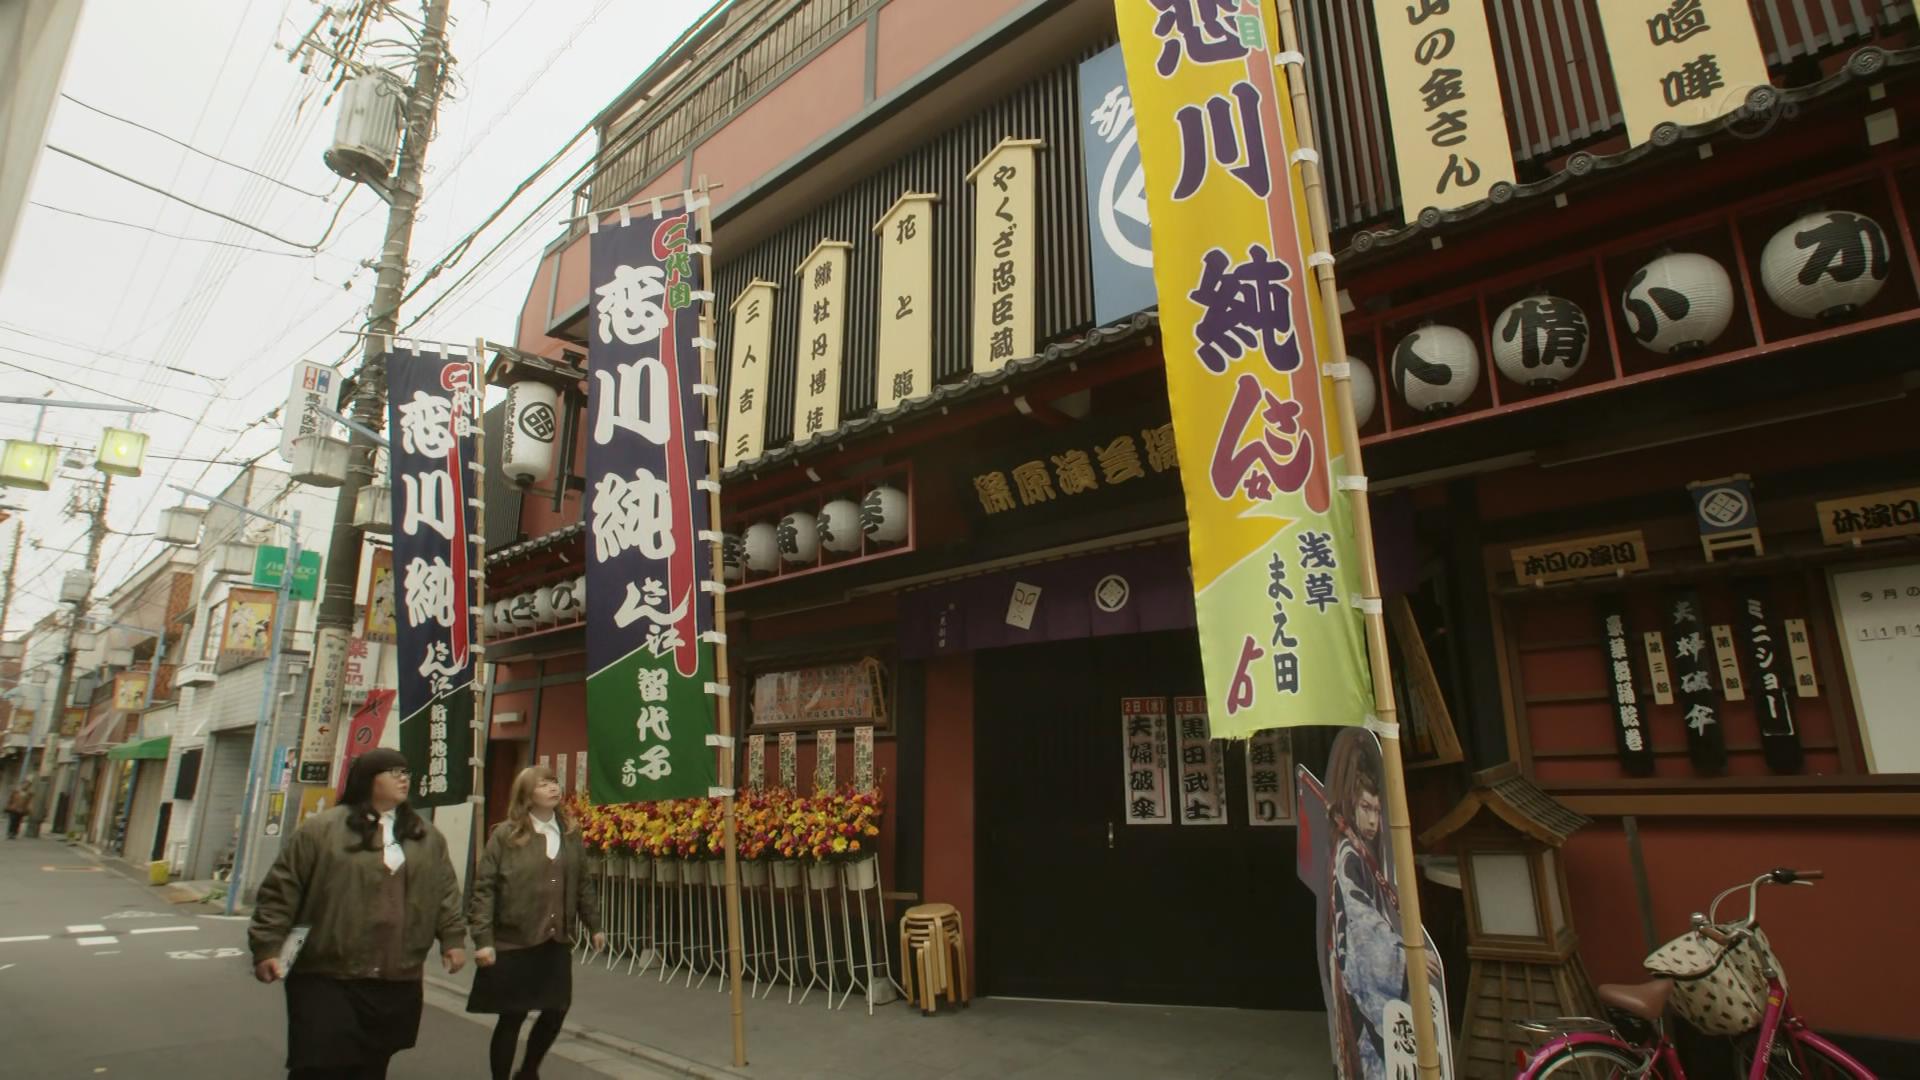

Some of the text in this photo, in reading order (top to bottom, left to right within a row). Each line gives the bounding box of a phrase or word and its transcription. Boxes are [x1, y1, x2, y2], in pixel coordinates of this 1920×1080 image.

[892, 214, 917, 401] 花と龍
[990, 165, 1017, 362] やくざ忠臣蔵
[735, 299, 760, 457] 三人吉三
[807, 261, 832, 433] 緋牡丹博徒
[1267, 552, 1299, 694] まえ田
[1297, 529, 1339, 613] 浅草
[1747, 599, 1779, 718] ミニショー
[1182, 717, 1209, 819] 黒田武士
